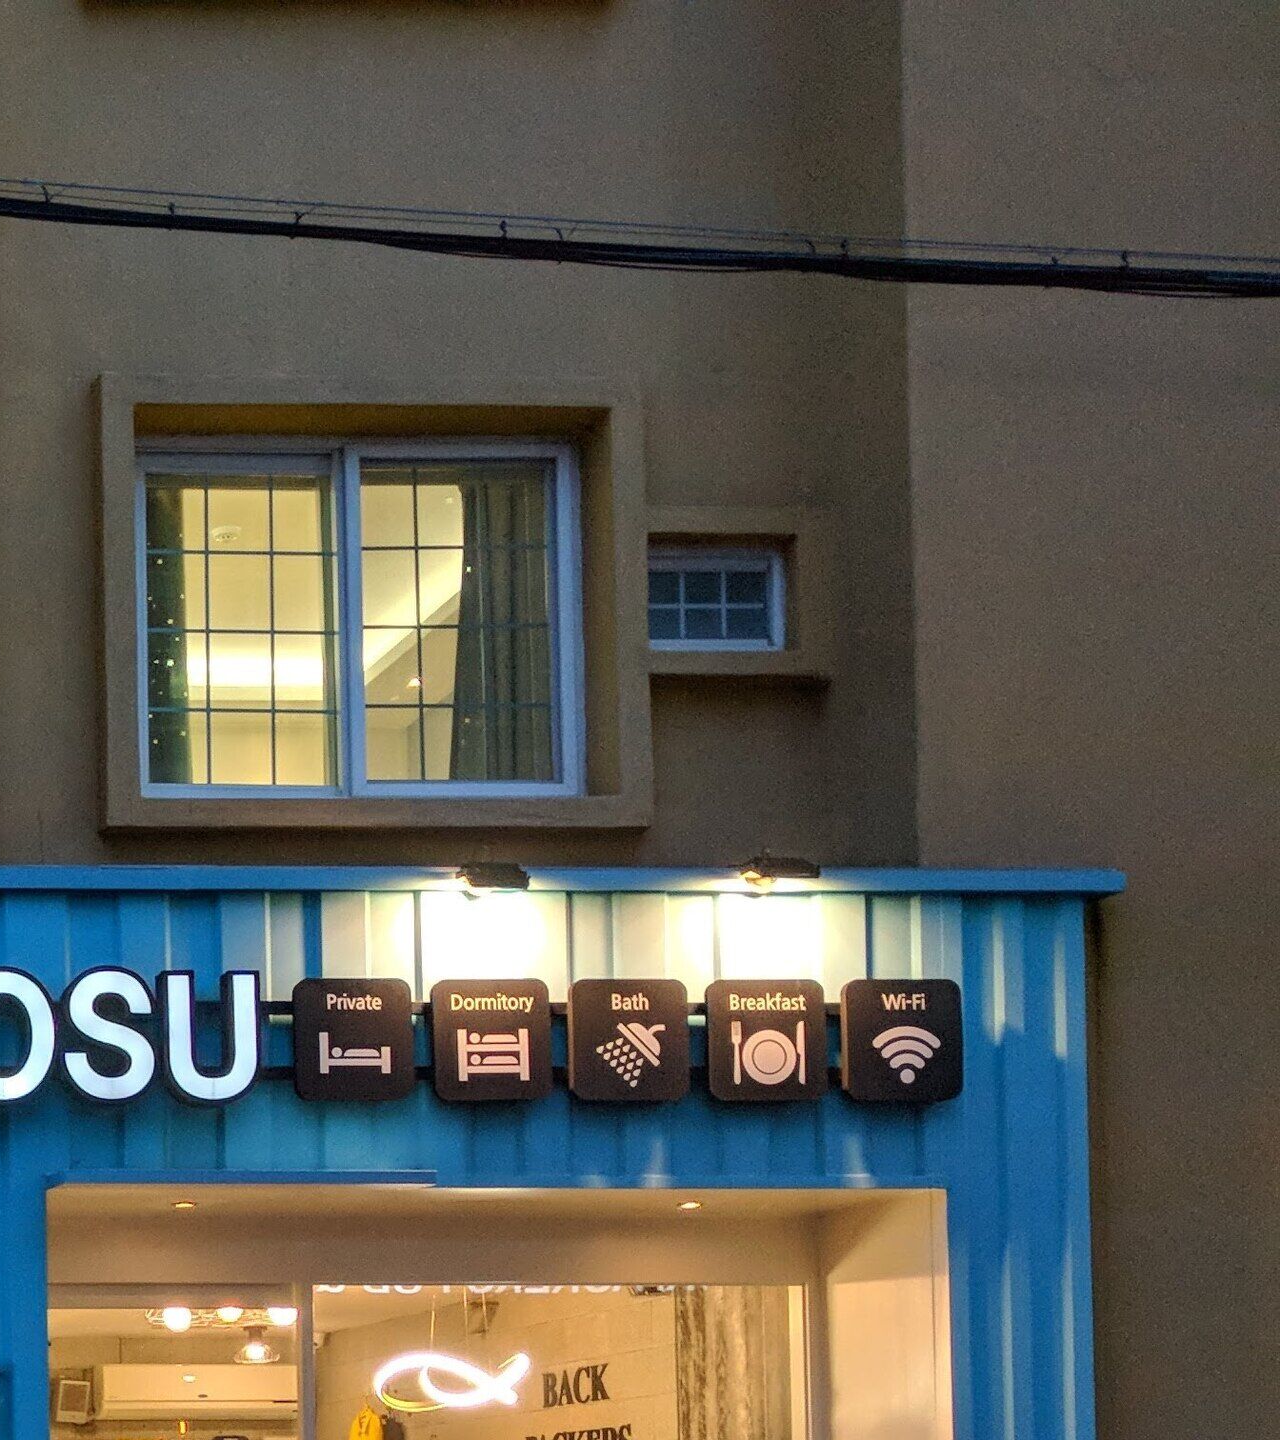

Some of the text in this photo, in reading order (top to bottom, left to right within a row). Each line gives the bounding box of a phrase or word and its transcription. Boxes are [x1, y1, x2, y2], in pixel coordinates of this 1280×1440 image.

[326, 993, 383, 1012] Private
[450, 993, 533, 1016] Dormitory
[611, 993, 649, 1012] Bath
[729, 993, 806, 1012] Breakfast
[882, 993, 926, 1012] Wi-Fi
[542, 1363, 610, 1408] BACK
